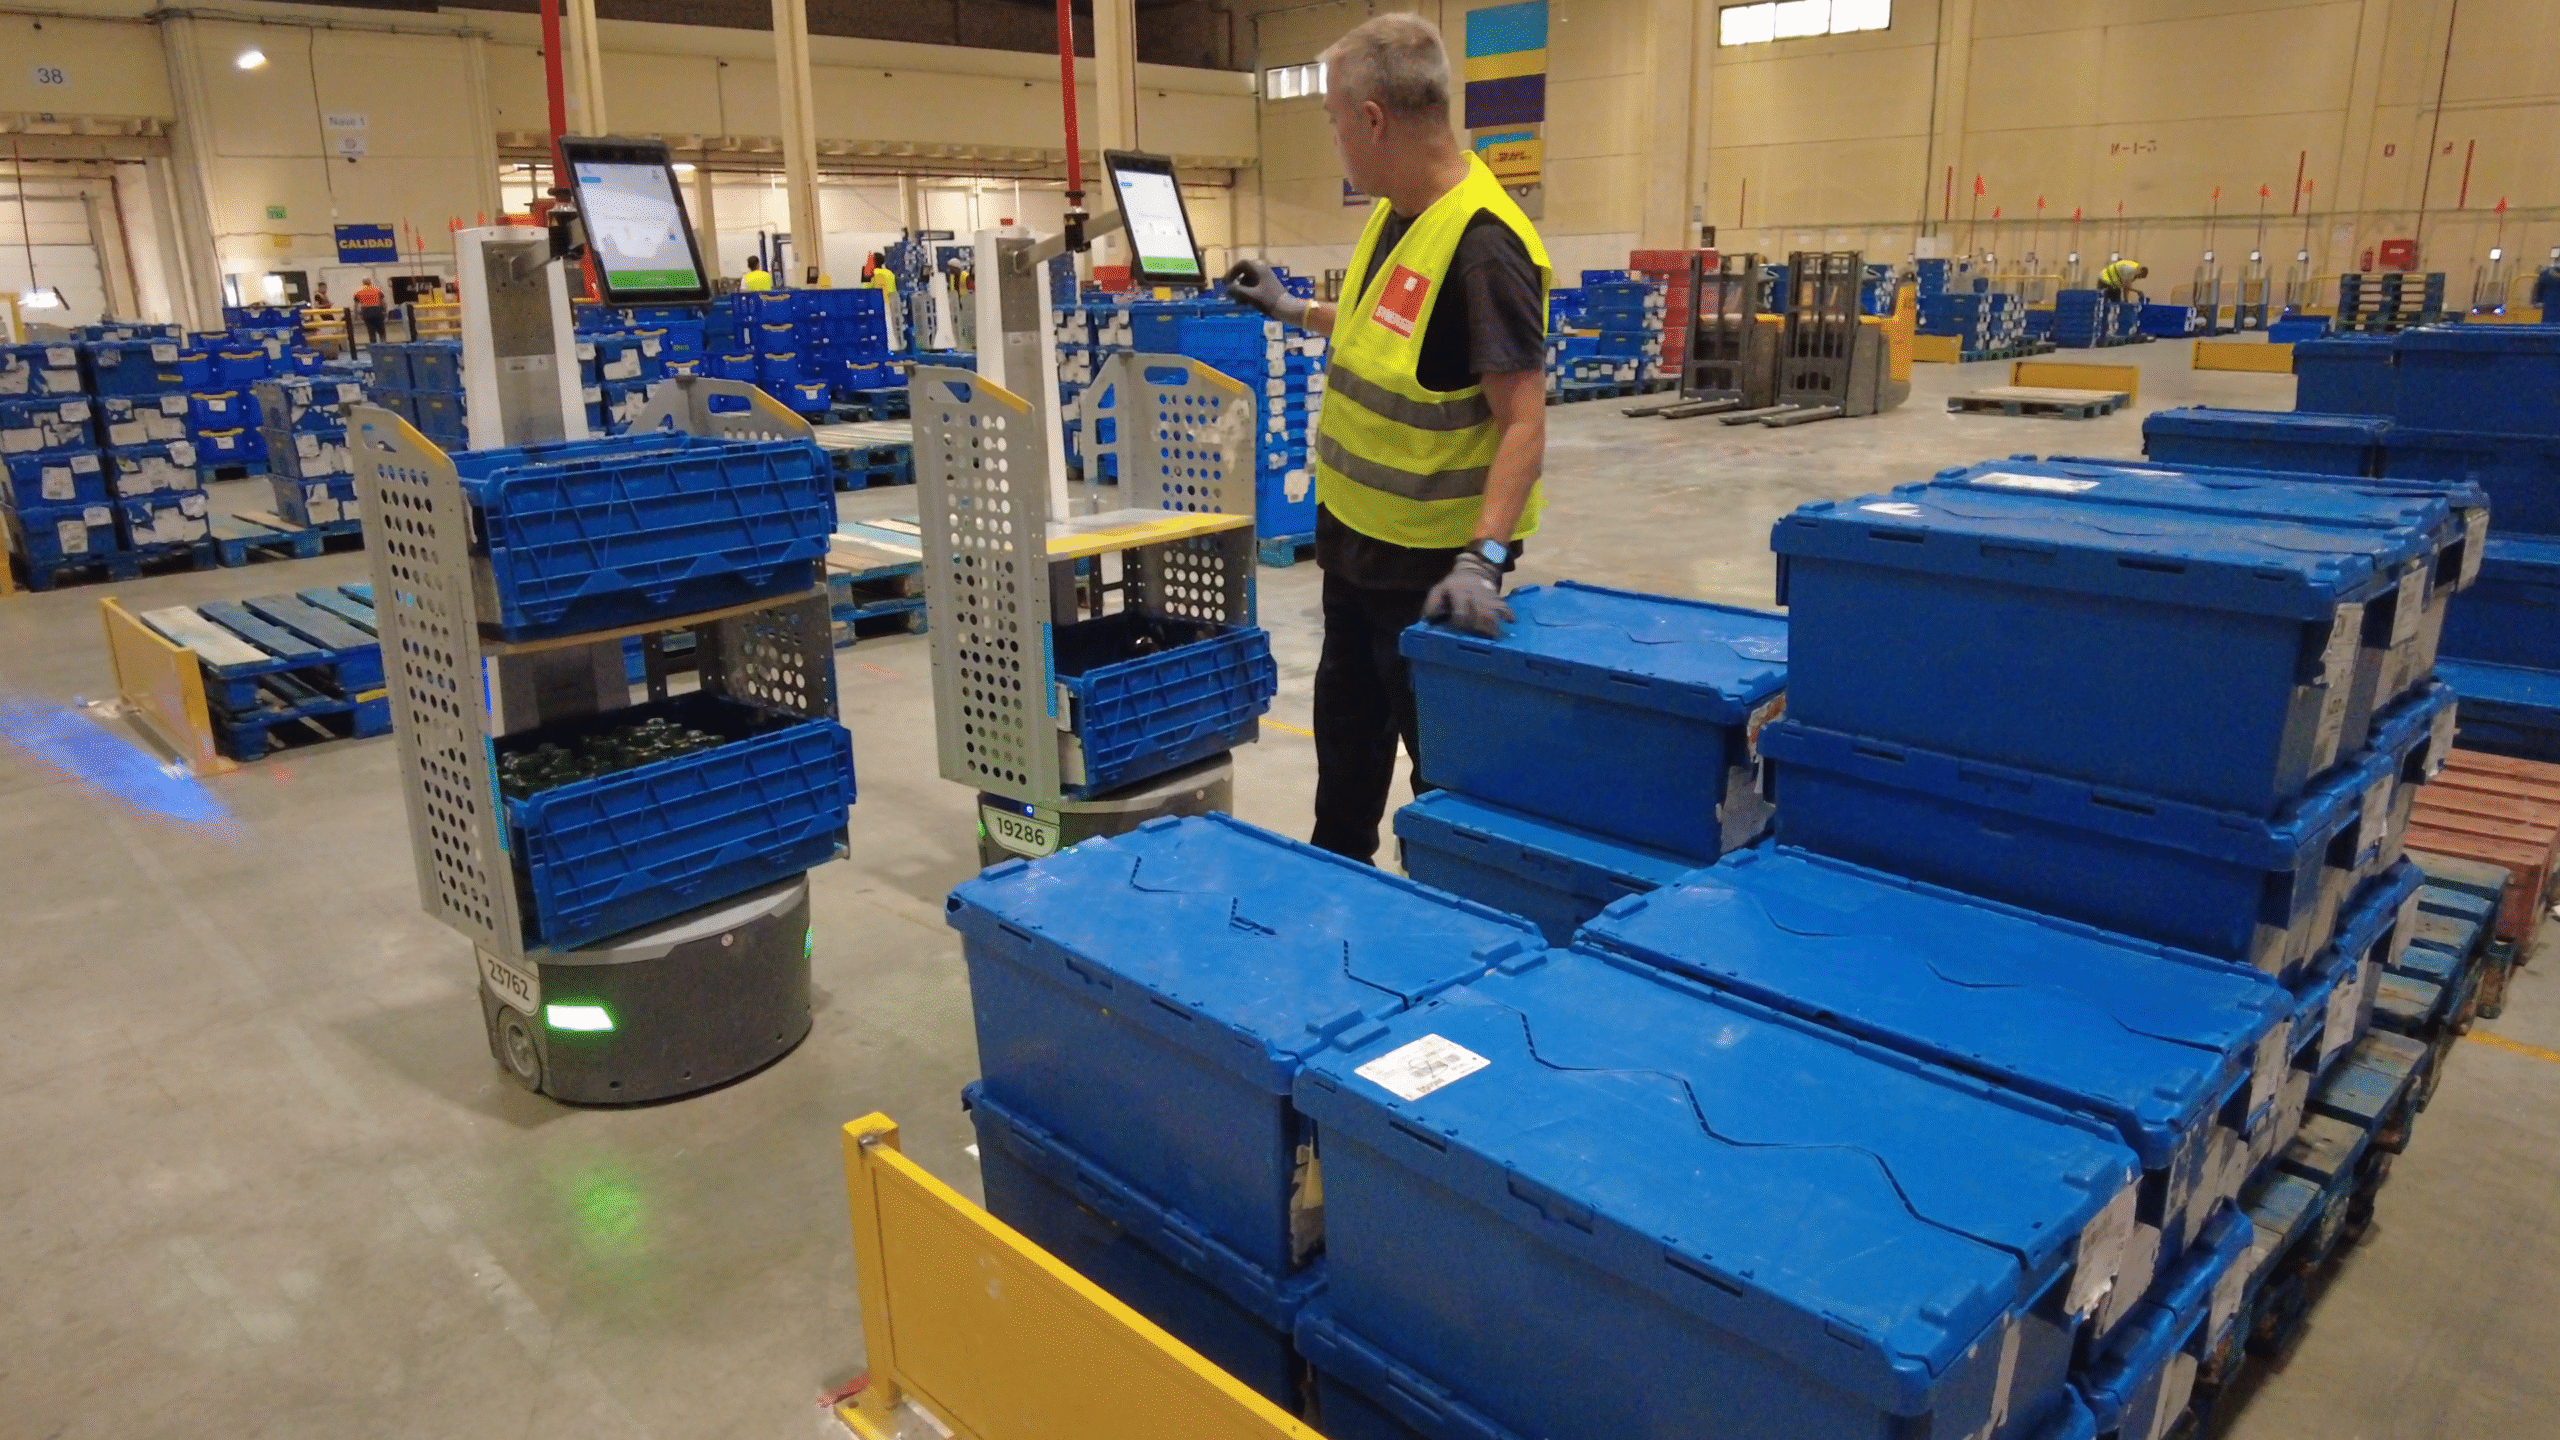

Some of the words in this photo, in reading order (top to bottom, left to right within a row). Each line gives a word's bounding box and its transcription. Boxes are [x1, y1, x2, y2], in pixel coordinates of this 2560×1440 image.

[38, 67, 63, 84] 38
[339, 238, 393, 249] CALIDAD
[997, 817, 1045, 845] 19286
[487, 959, 530, 1001] 23762
